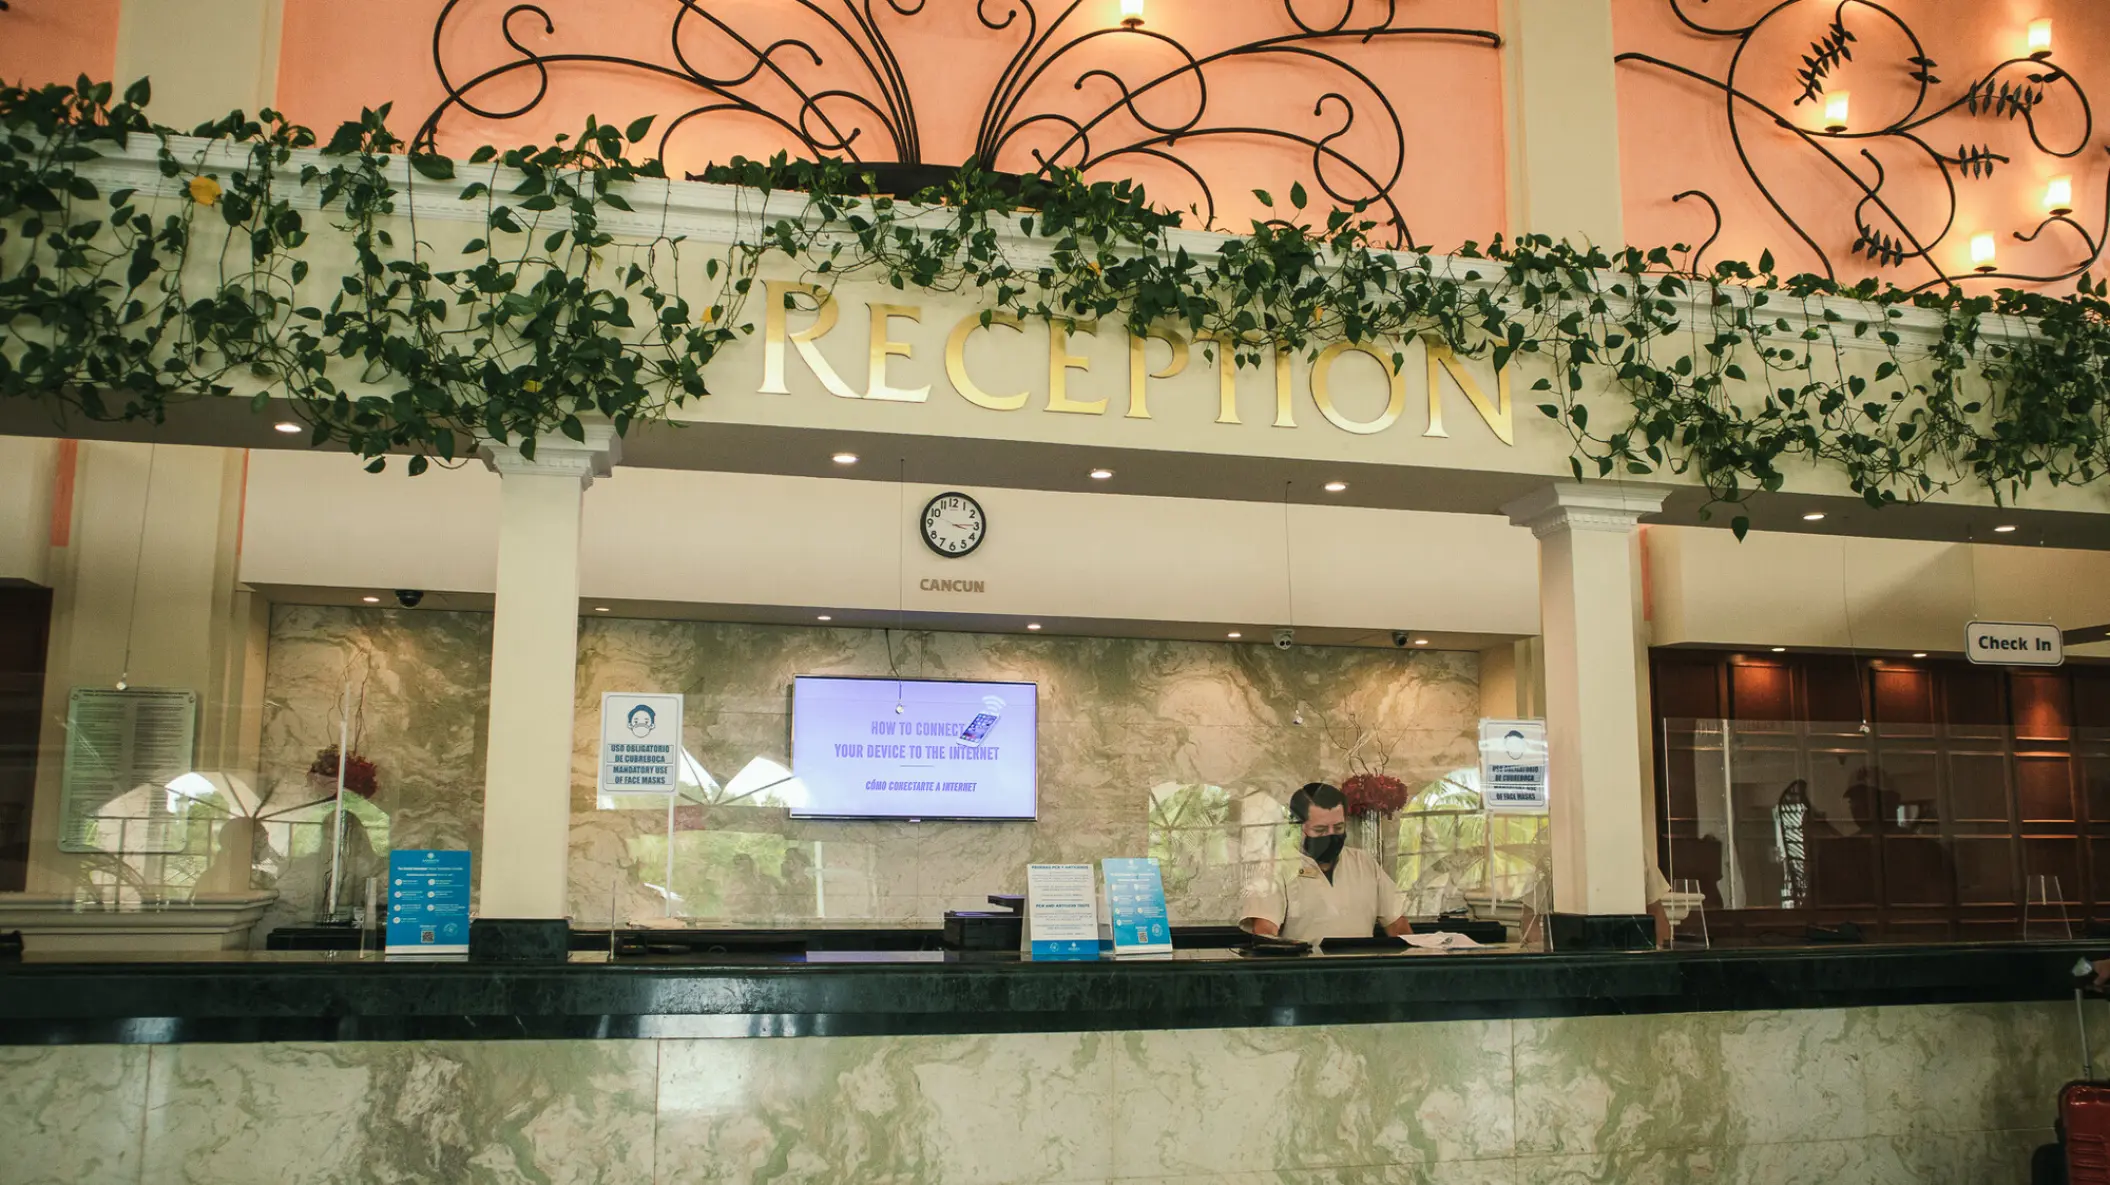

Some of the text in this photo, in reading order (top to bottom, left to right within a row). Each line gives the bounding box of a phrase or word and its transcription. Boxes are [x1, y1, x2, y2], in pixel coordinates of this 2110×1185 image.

[756, 278, 1514, 447] RECEPTION
[940, 500, 947, 510] 11
[949, 498, 959, 508] 12
[931, 508, 941, 518] 10
[969, 509, 976, 519] 2
[926, 518, 934, 528] 9
[973, 521, 980, 531] 3
[930, 530, 937, 540] 8
[968, 532, 976, 541] 4
[939, 537, 946, 547] 7
[949, 541, 956, 551] 6
[960, 539, 967, 549] 5
[920, 578, 985, 593] CANCUN
[1978, 635, 2052, 652] Check In
[871, 721, 966, 737] HOW TO CONNECT
[611, 744, 670, 753] USO OBLIGATORIO
[834, 743, 1000, 761] YOUR DEVICE TO THE INTERNET
[615, 754, 666, 763] DE CUBREBOCA
[612, 765, 668, 774] MANDATORY USE
[615, 776, 666, 785] OF FACE MASKS
[865, 779, 977, 792] CÓMO CONECTARTE A INTERNET
